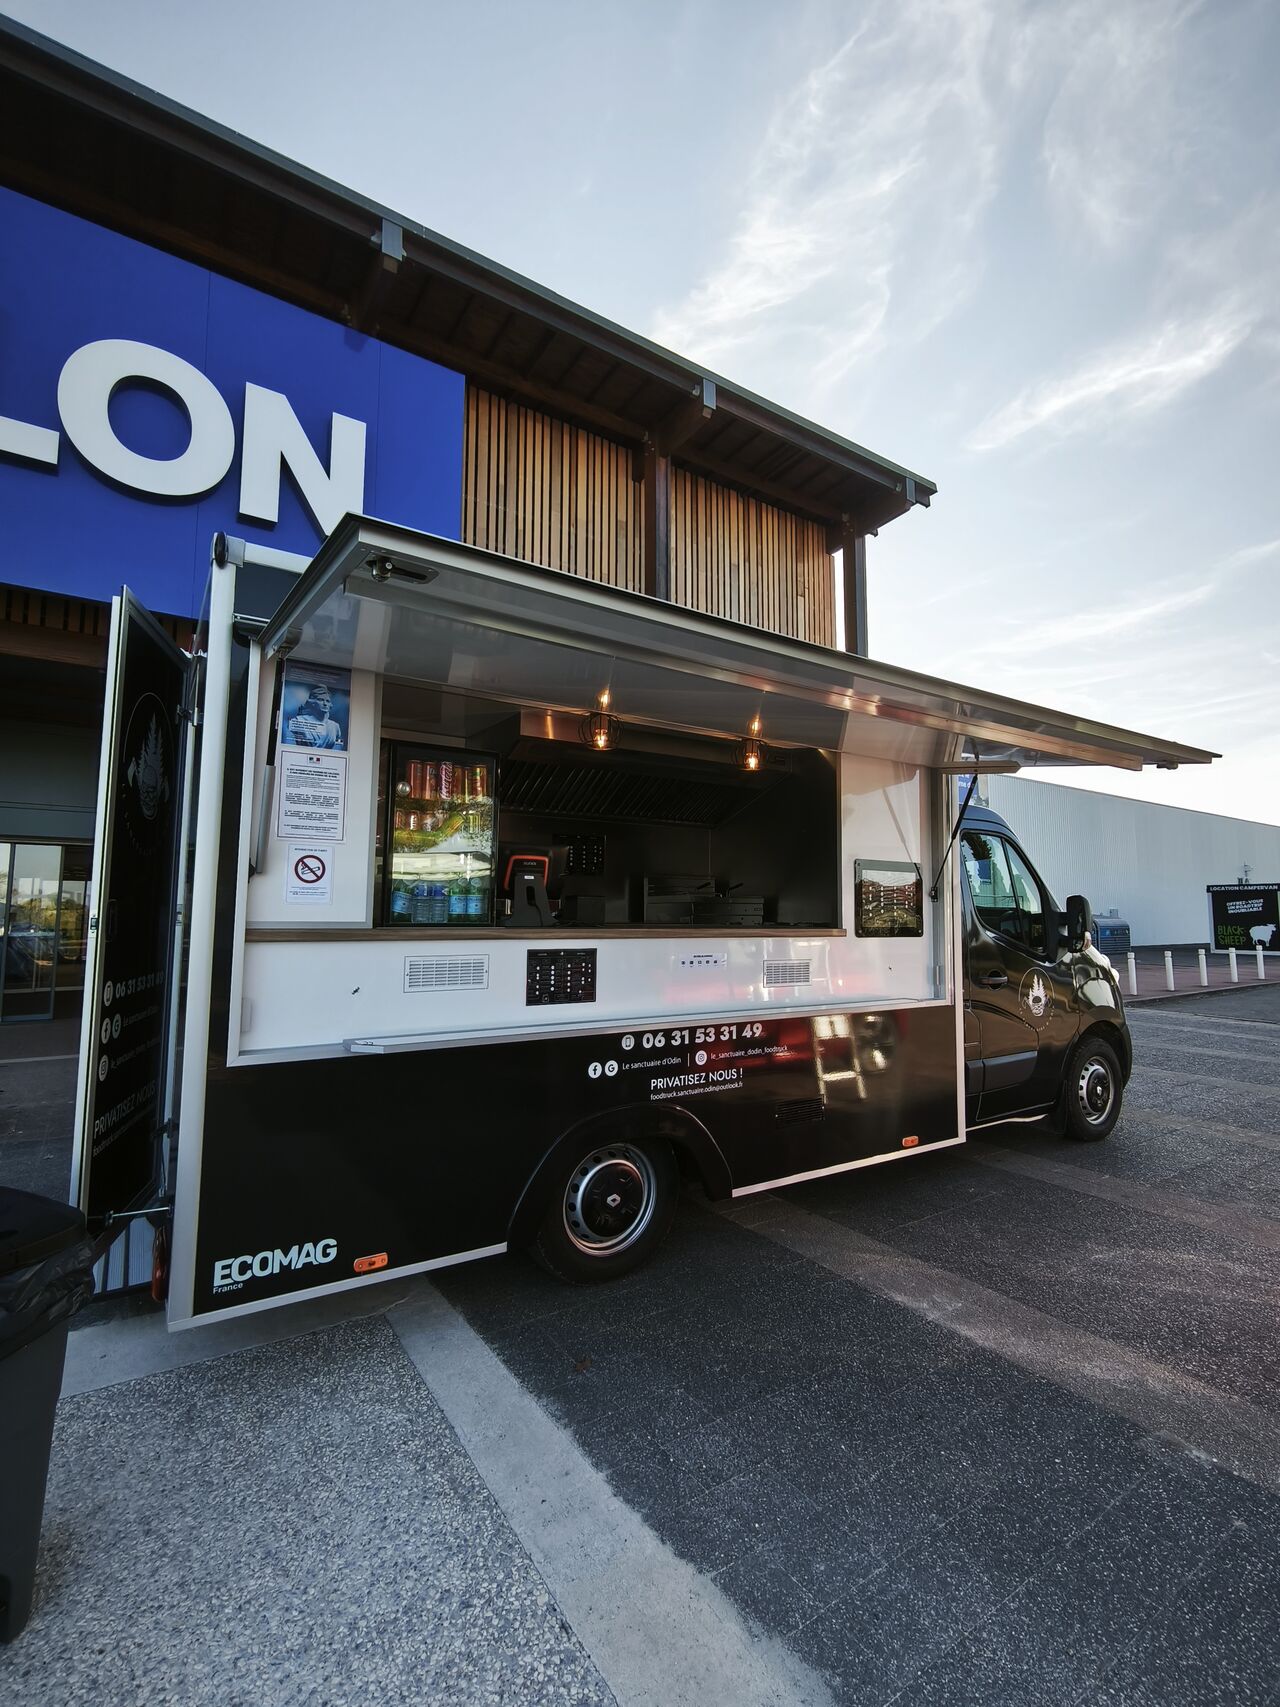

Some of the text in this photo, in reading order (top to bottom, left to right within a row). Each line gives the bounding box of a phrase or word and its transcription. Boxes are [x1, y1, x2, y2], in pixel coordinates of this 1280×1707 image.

[0, 338, 367, 537] ON
[1218, 925, 1246, 935] BLACK
[1218, 935, 1246, 945] SHEEP
[642, 1023, 763, 1049] 06 31 53 31 49
[710, 1045, 788, 1060] le_sanctuaire_dodin_foodtruck
[630, 1059, 661, 1069] sanctuaire
[662, 1057, 682, 1065] d'Odin
[650, 1072, 706, 1090] PRIVATISEZ
[709, 1068, 737, 1082] NOUS
[650, 1081, 744, 1100] foodtruck.sanctuaire.odin@outlook.fr
[94, 1093, 135, 1140] PRIVATISEZ
[213, 1238, 338, 1287] ECOMAG
[212, 1282, 244, 1295] France
